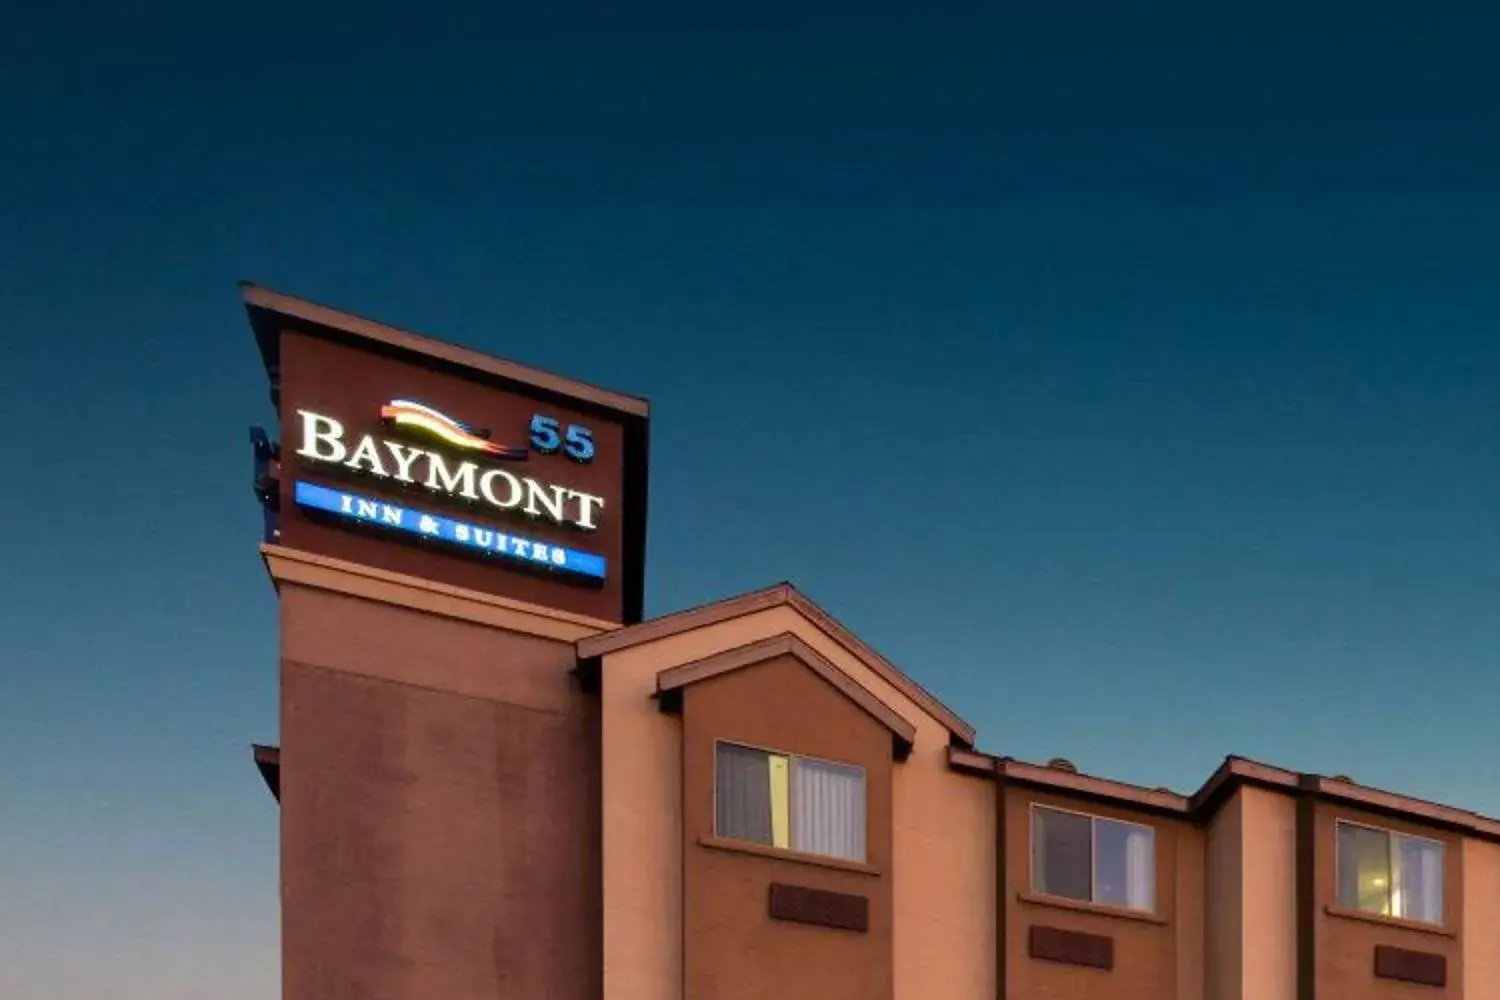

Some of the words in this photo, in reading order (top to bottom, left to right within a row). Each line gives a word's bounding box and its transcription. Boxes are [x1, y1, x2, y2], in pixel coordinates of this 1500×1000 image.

[296, 410, 605, 530] BAYMONT
[529, 414, 596, 462] 55
[340, 495, 404, 525] INN
[419, 514, 441, 536] &
[455, 524, 567, 565] SUITES
